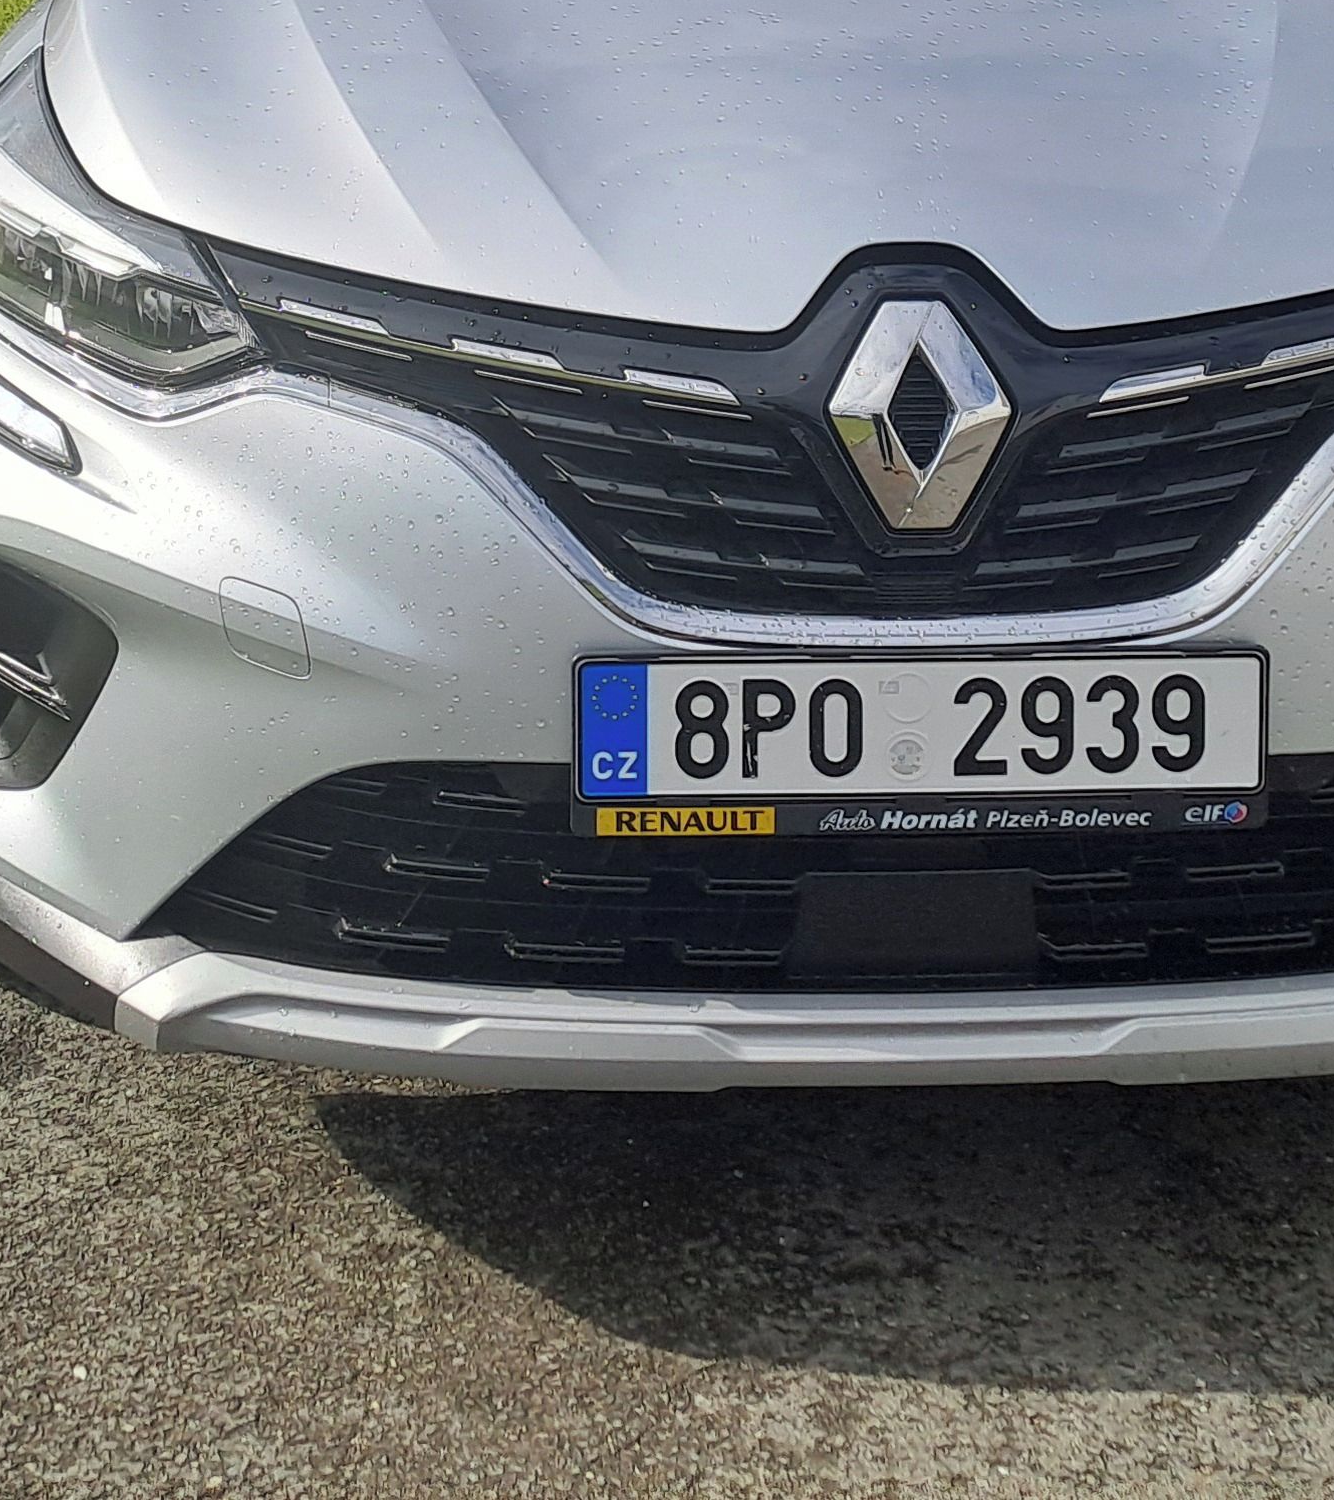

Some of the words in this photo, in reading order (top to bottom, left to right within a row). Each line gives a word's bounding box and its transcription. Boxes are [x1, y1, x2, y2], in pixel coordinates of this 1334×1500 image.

[674, 678, 864, 779] 8P0
[953, 673, 1206, 777] 2939
[591, 750, 638, 781] CZ
[615, 811, 766, 833] RENAULT
[819, 809, 876, 831] Auto
[880, 808, 977, 829] Hornát
[985, 808, 1153, 828] Plzeň-Bolevec
